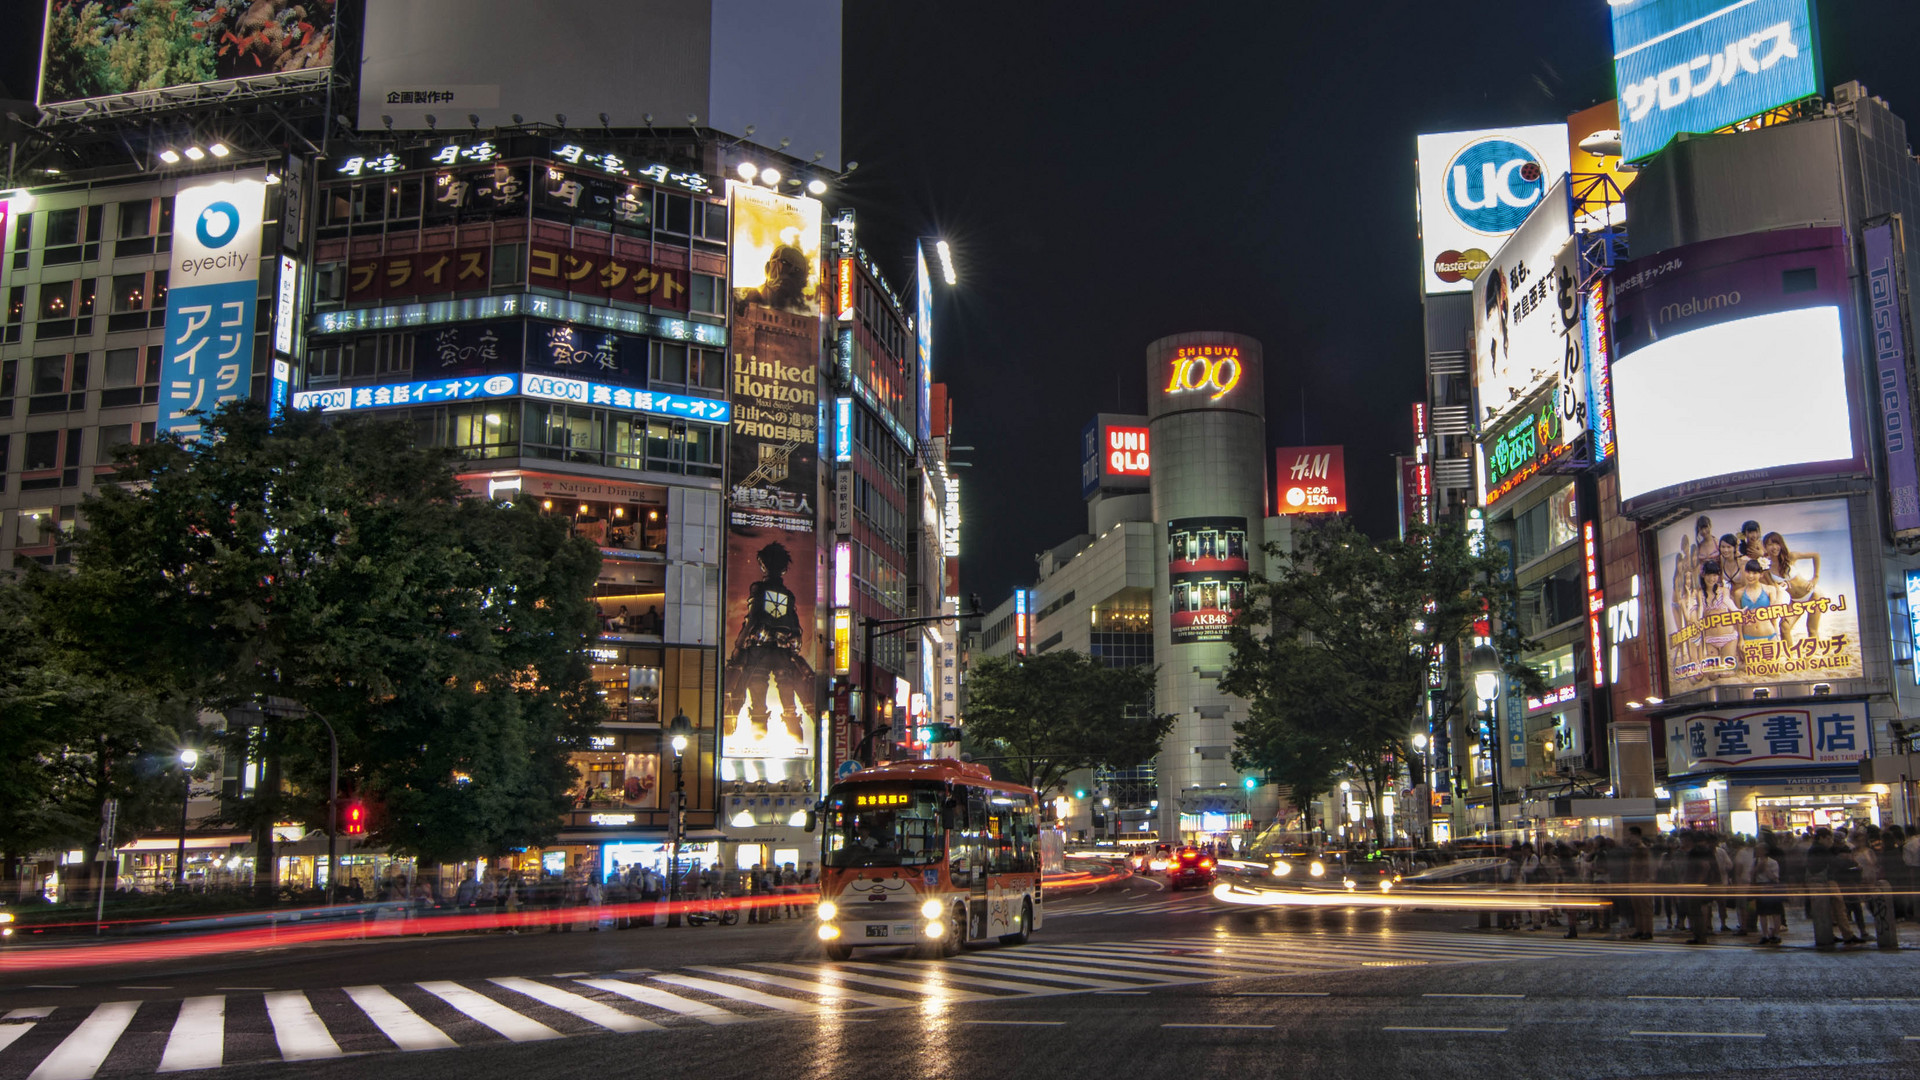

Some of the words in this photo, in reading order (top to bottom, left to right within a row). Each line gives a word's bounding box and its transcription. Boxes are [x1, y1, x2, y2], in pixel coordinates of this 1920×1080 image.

[1622, 21, 1798, 122] サロンパス
[386, 91, 454, 105] 企画製作中
[438, 176, 451, 186] 9F
[549, 171, 565, 180] 9F
[288, 171, 299, 236] 大外ビル
[181, 252, 249, 276] eyecity
[351, 252, 485, 292] プライス
[531, 249, 685, 299] コンタクト
[1645, 258, 1682, 281] チャンネル
[504, 300, 516, 311] 7F
[533, 301, 548, 312] 7F
[1870, 257, 1899, 361] Taisei
[1179, 347, 1239, 357] SHIBUYA
[734, 353, 815, 385] Linked
[1165, 356, 1242, 400] 109
[355, 381, 480, 407] 英会話イーオン
[528, 378, 583, 399] AEON
[593, 385, 726, 418] 英会話イーオン
[734, 374, 816, 406] Horizon
[734, 404, 815, 429] 自由への進撃
[1880, 367, 1904, 453] neon
[734, 419, 815, 444] 7月10日発売
[1110, 431, 1146, 451] UNI
[1111, 451, 1150, 472] QLO
[1290, 453, 1330, 481] H&M
[559, 482, 602, 494] Natural
[607, 486, 645, 499] Dining
[732, 484, 813, 515] 進撃の巨人
[839, 475, 848, 529] 渋谷駅前ビル
[1306, 486, 1329, 495] この先
[1306, 495, 1338, 506] 150m
[1192, 614, 1227, 625] AKB48
[1745, 634, 1847, 664] 常夏ハイタッチ
[1746, 663, 1781, 675] NOW
[1784, 661, 1806, 672] ON
[1810, 656, 1849, 670] SALE!!
[1670, 713, 1856, 765] 大盛堂書店
